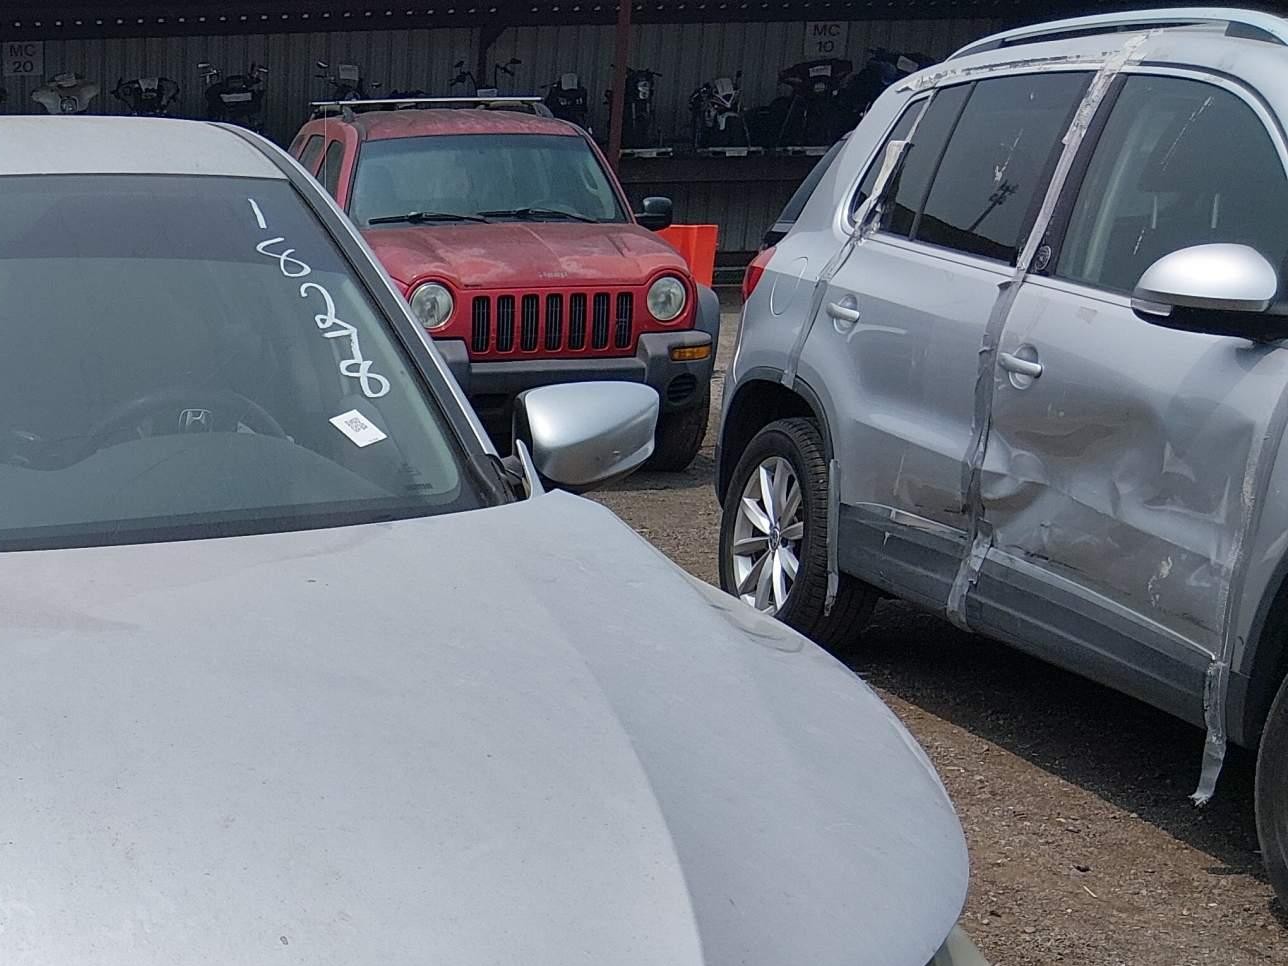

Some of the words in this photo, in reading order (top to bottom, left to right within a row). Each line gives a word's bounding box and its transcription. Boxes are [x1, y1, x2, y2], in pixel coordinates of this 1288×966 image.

[813, 24, 841, 37] MC
[9, 44, 36, 57] MC
[816, 40, 834, 53] 10
[12, 60, 34, 73] 20
